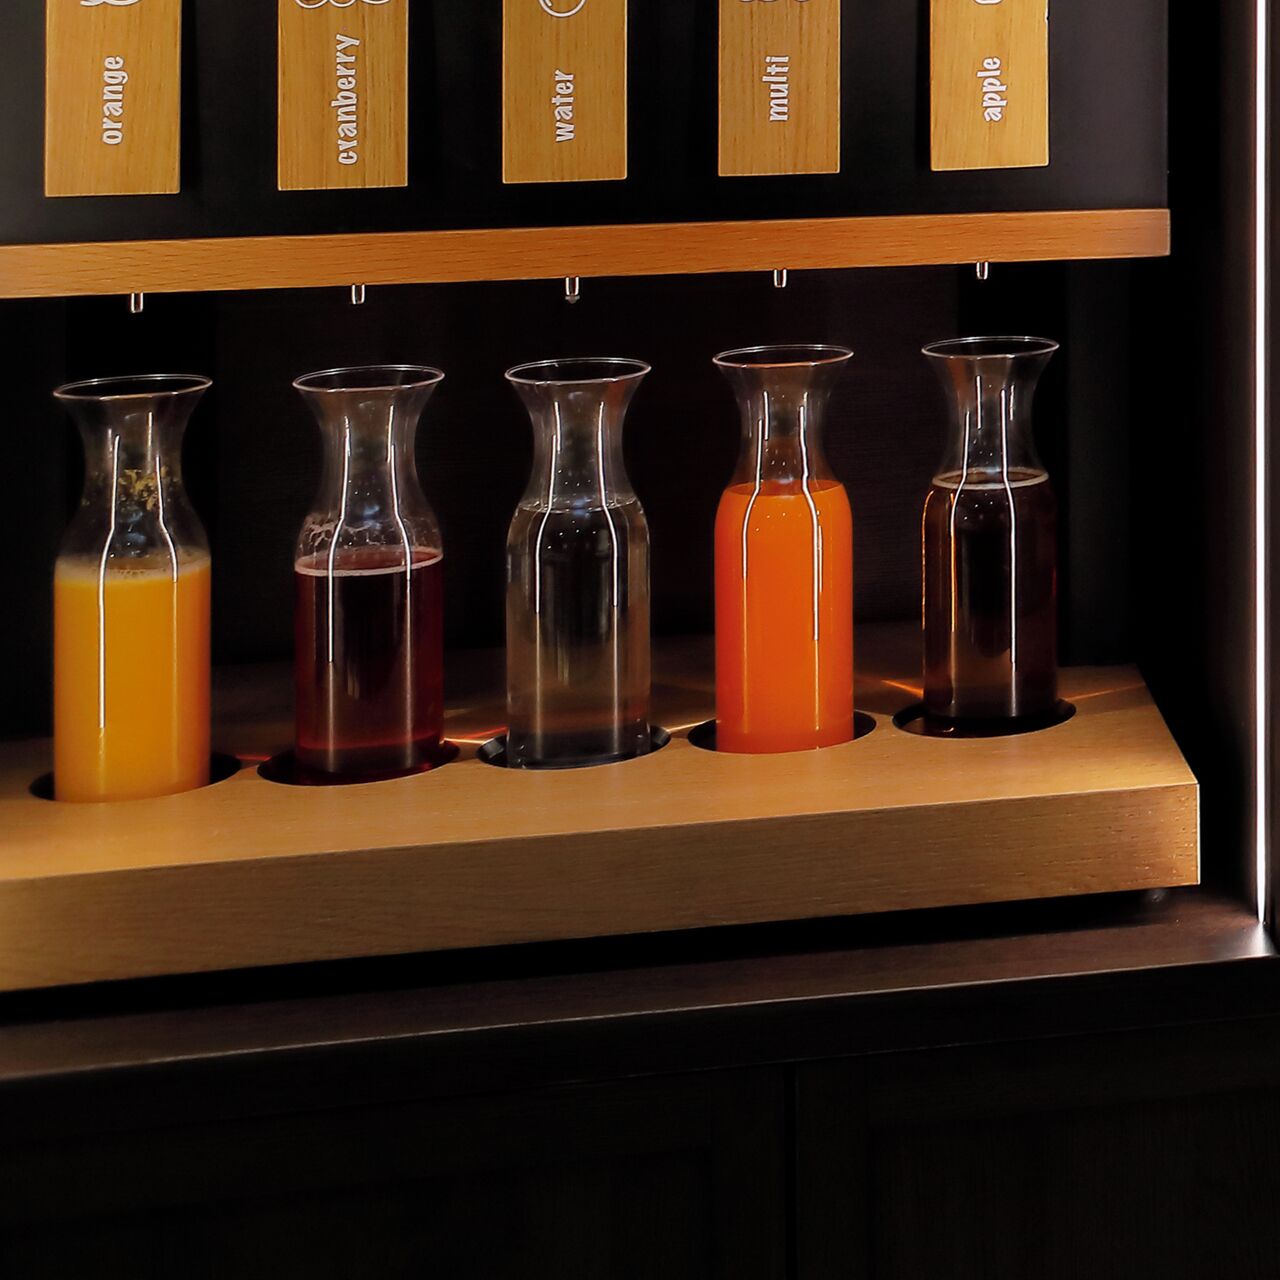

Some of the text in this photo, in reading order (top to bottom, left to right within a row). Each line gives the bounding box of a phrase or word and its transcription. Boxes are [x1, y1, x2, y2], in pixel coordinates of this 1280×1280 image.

[102, 55, 129, 146] orange
[331, 33, 361, 166] cranberry
[551, 69, 575, 143] water
[762, 55, 790, 122] multi
[977, 56, 1008, 122] apple
